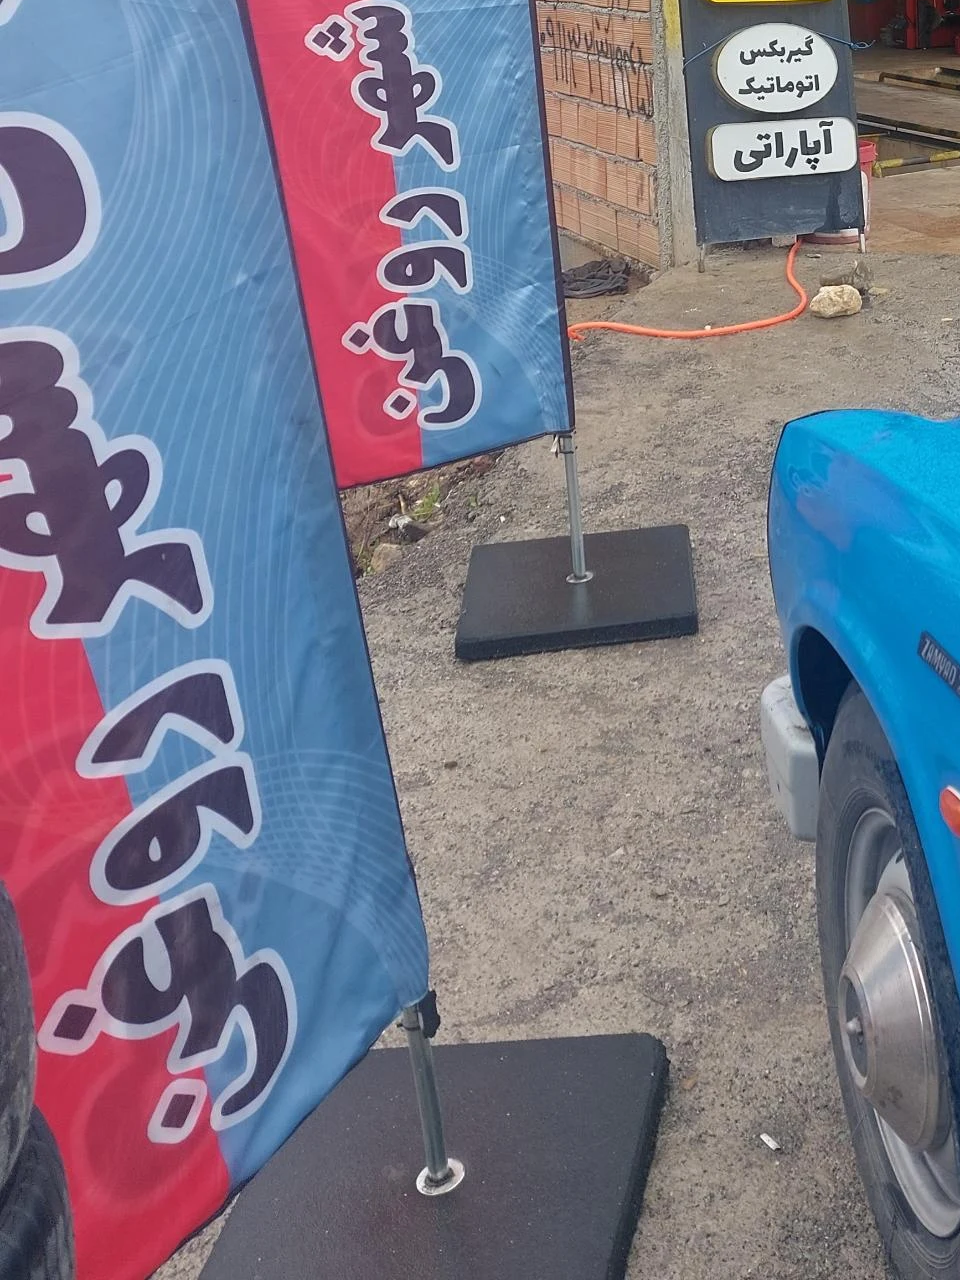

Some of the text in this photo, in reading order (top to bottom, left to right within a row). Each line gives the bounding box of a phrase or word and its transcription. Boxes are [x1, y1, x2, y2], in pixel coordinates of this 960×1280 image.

[305, 0, 461, 172] شهر
[738, 74, 819, 101] اتوماتیک
[739, 33, 814, 66] گیربکس
[733, 120, 833, 172] آپاراتی
[342, 187, 483, 430] روغن
[37, 658, 298, 1145] روغن
